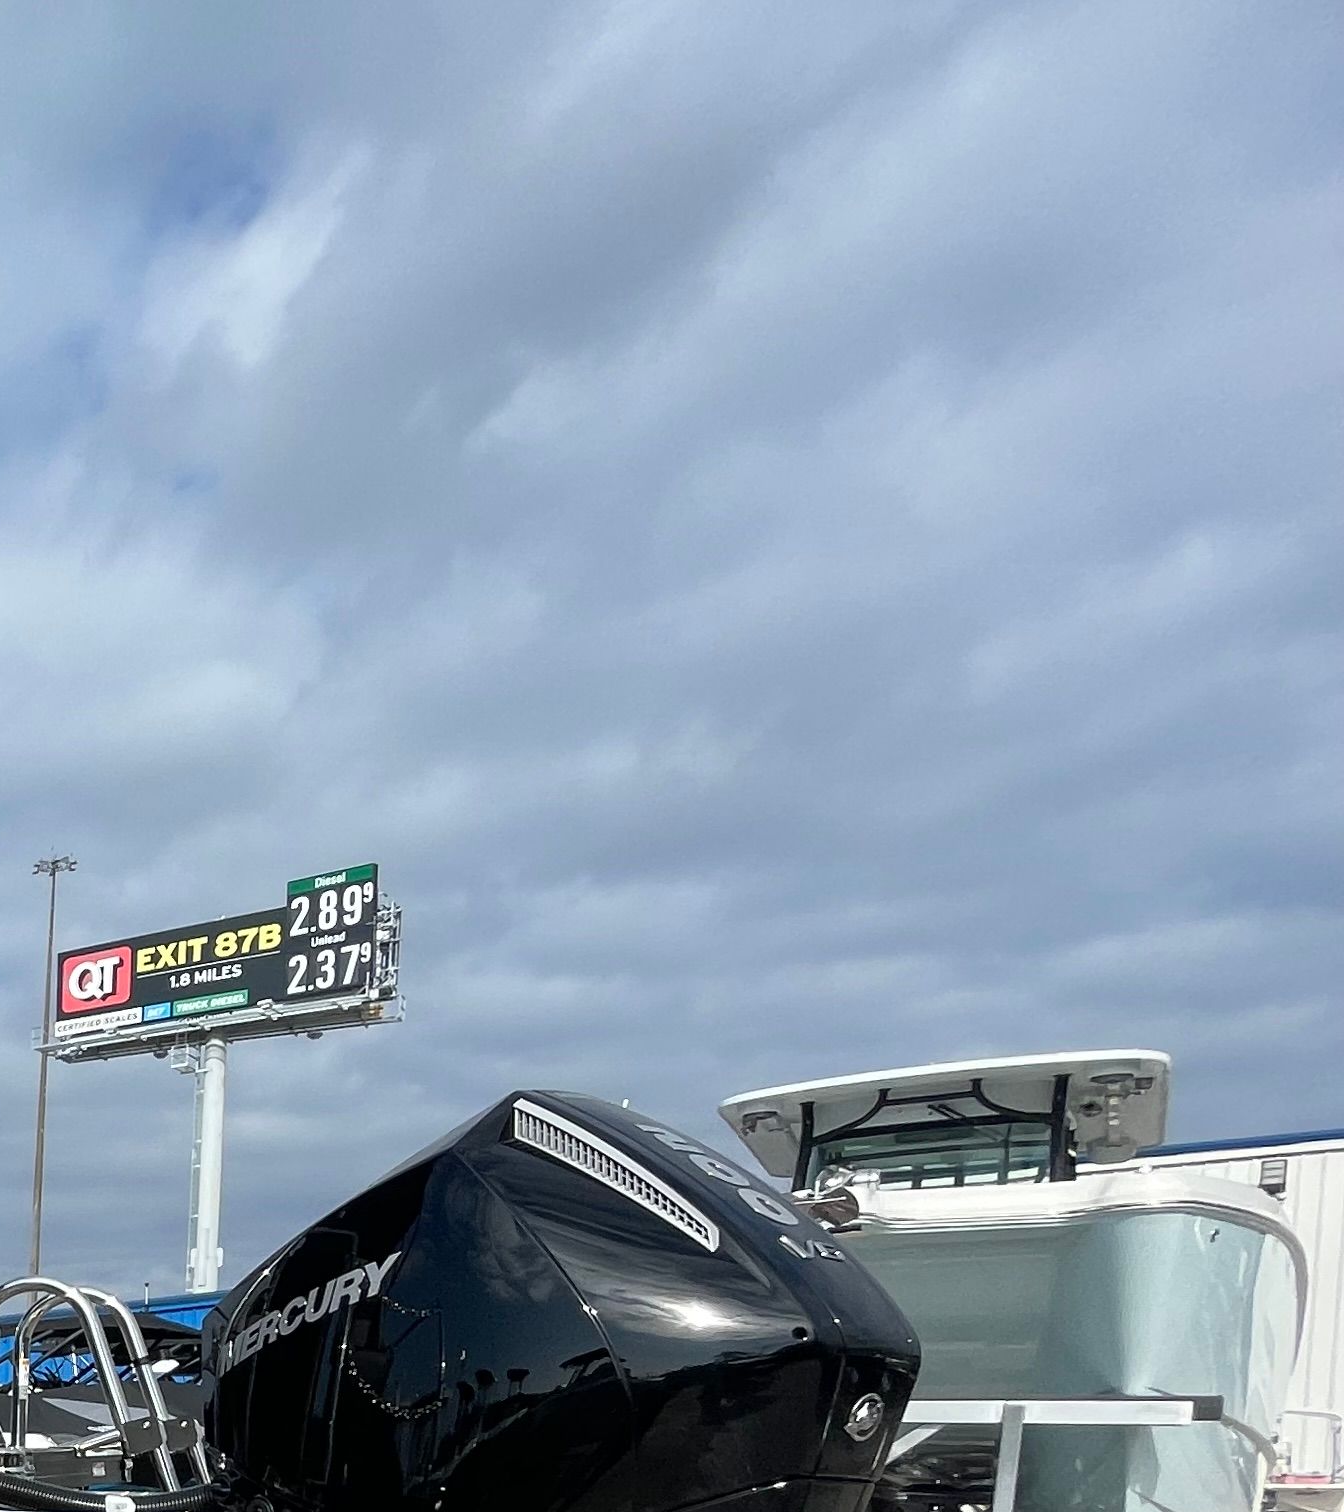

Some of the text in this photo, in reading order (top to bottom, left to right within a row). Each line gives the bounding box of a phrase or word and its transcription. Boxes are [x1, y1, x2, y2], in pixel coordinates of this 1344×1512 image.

[314, 872, 347, 889] Diesel
[136, 923, 282, 973] EXIT 87B
[310, 931, 346, 948] Unlead
[68, 955, 120, 1000] QT
[169, 963, 243, 988] 1.8 MILES
[176, 999, 209, 1013] TRUCK
[57, 1012, 139, 1033] CERTIFIED SCALES
[217, 1250, 403, 1379] MERCURY
